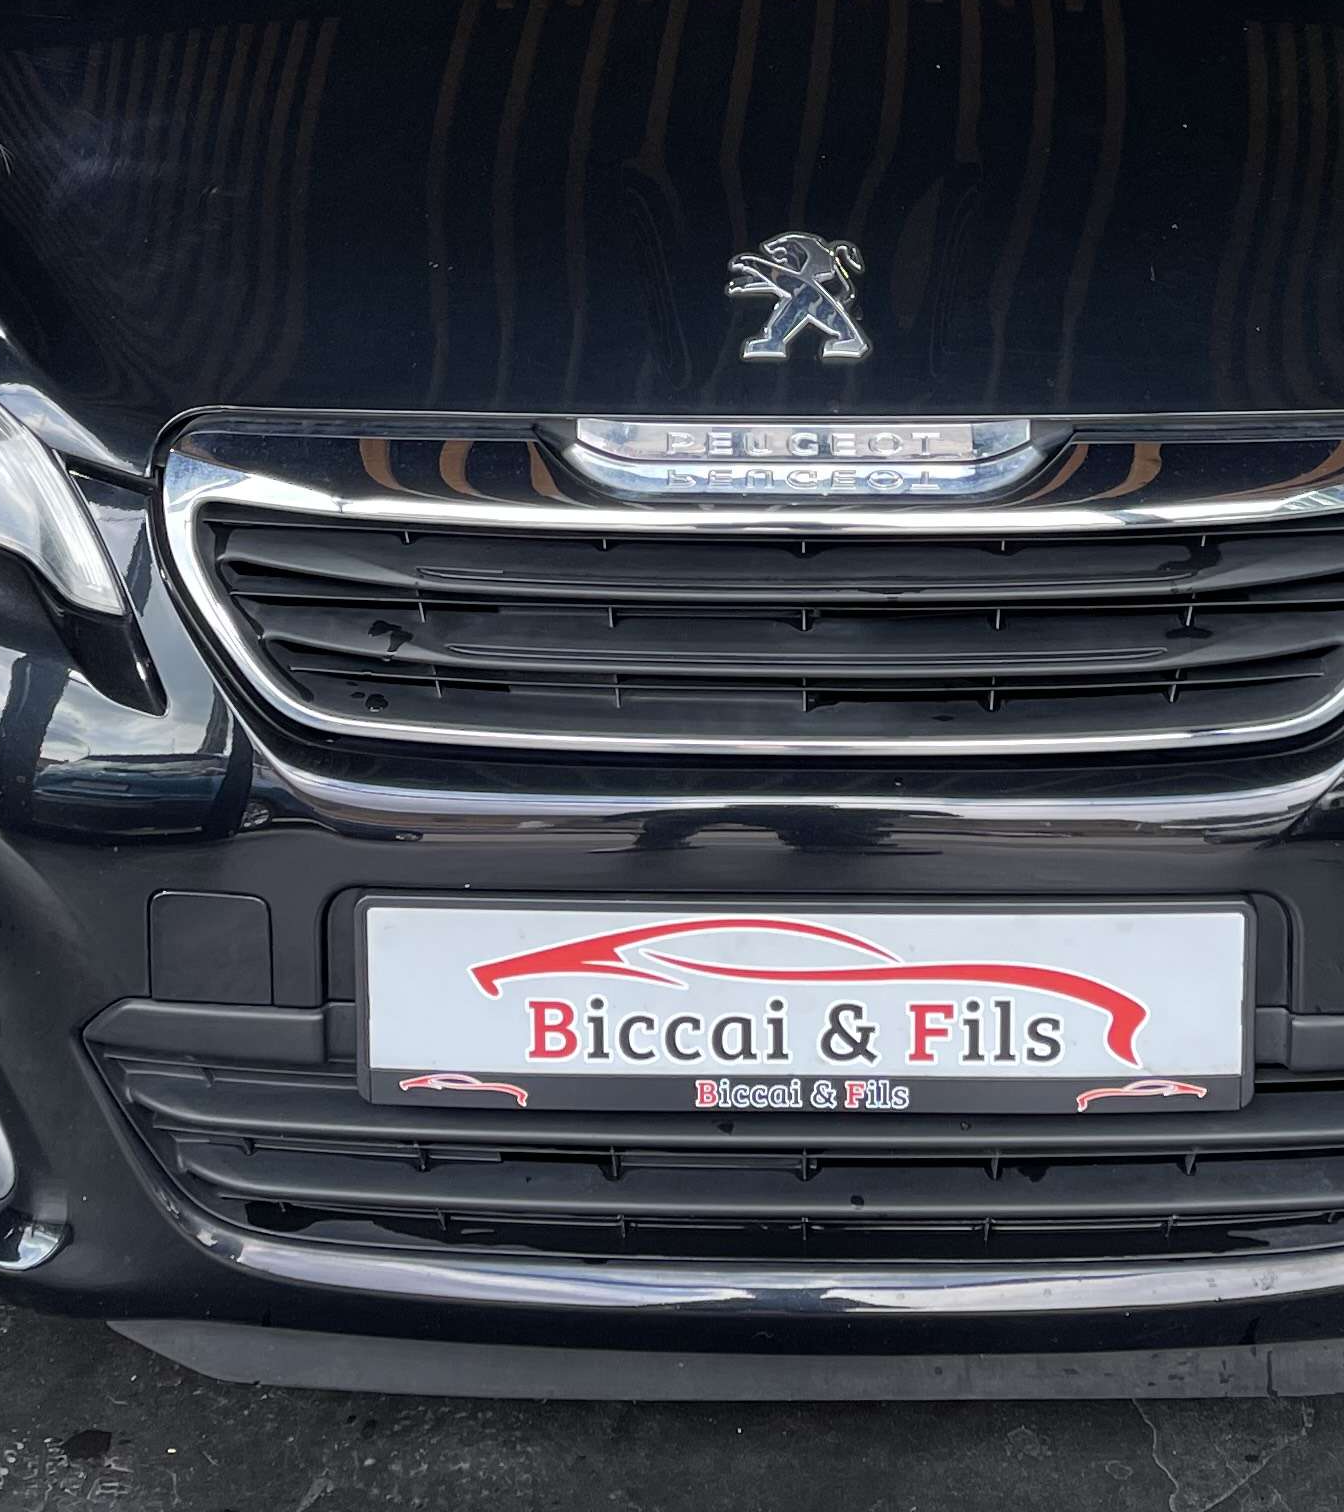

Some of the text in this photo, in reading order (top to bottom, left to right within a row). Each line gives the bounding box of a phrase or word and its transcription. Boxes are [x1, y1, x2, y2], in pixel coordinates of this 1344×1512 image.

[664, 431, 945, 457] PEUGEOT
[527, 997, 1063, 1064] Biccai & Fils
[696, 1077, 910, 1110] Biccai & Fils
